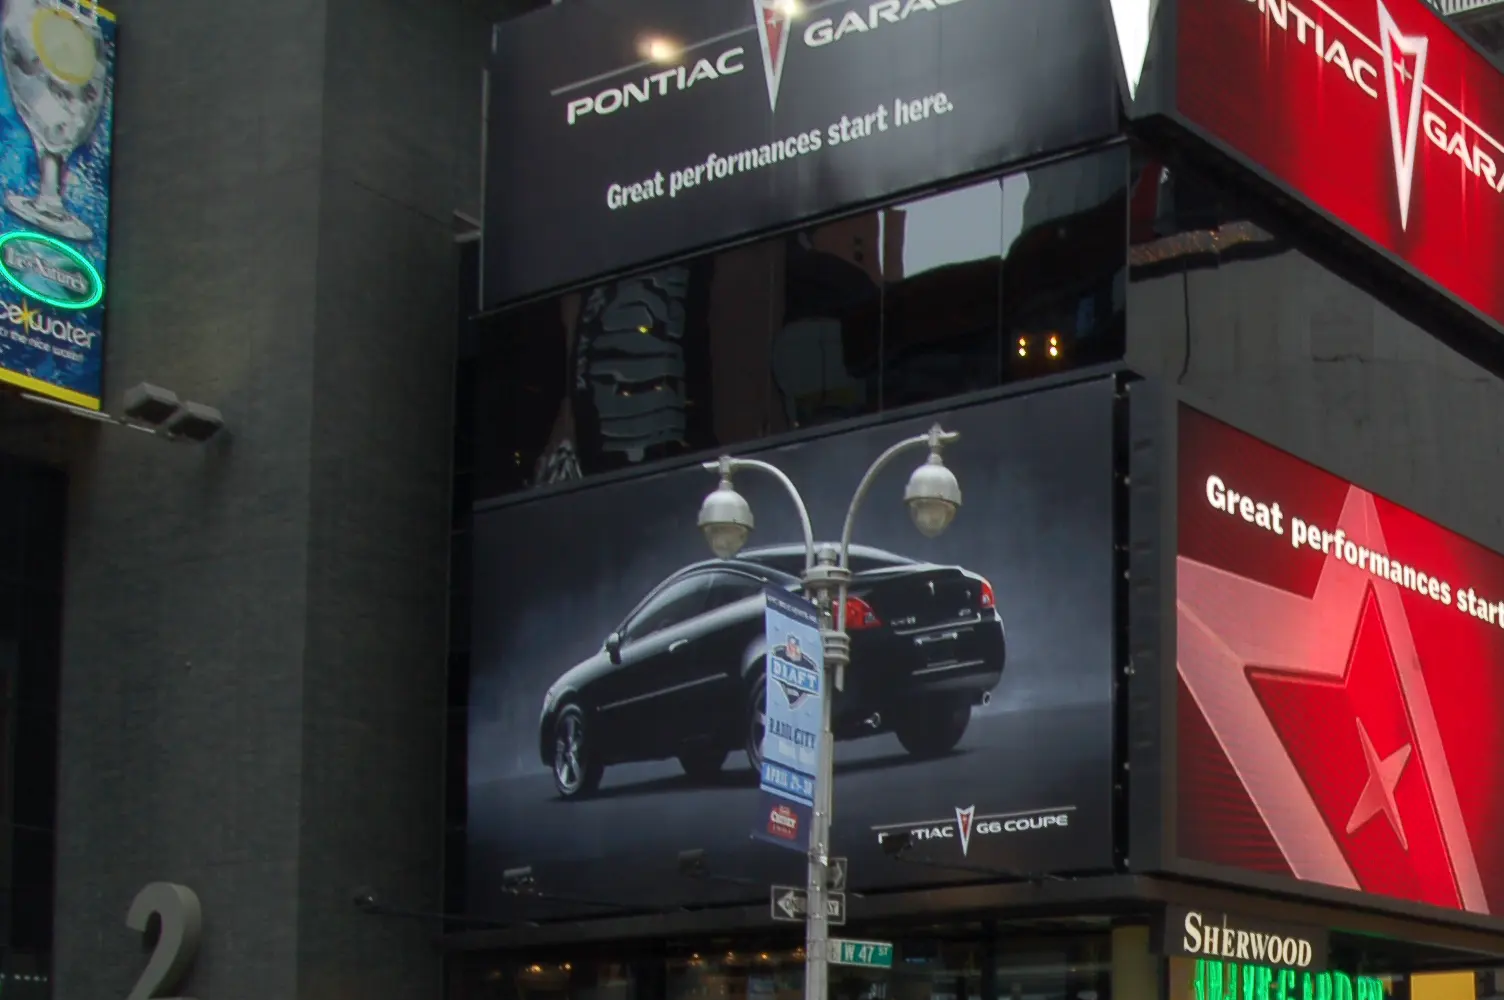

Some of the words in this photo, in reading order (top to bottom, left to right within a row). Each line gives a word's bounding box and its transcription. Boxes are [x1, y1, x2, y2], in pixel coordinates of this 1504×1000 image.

[567, 47, 744, 126] PONTIAC
[607, 172, 665, 210] Great
[670, 129, 821, 198] performances
[827, 103, 888, 147] start
[894, 91, 954, 127] here.
[1206, 474, 1284, 536] Great
[1291, 515, 1452, 606] performances
[976, 821, 1002, 835] G6
[1004, 814, 1069, 832] COUPE
[858, 944, 876, 963] 47
